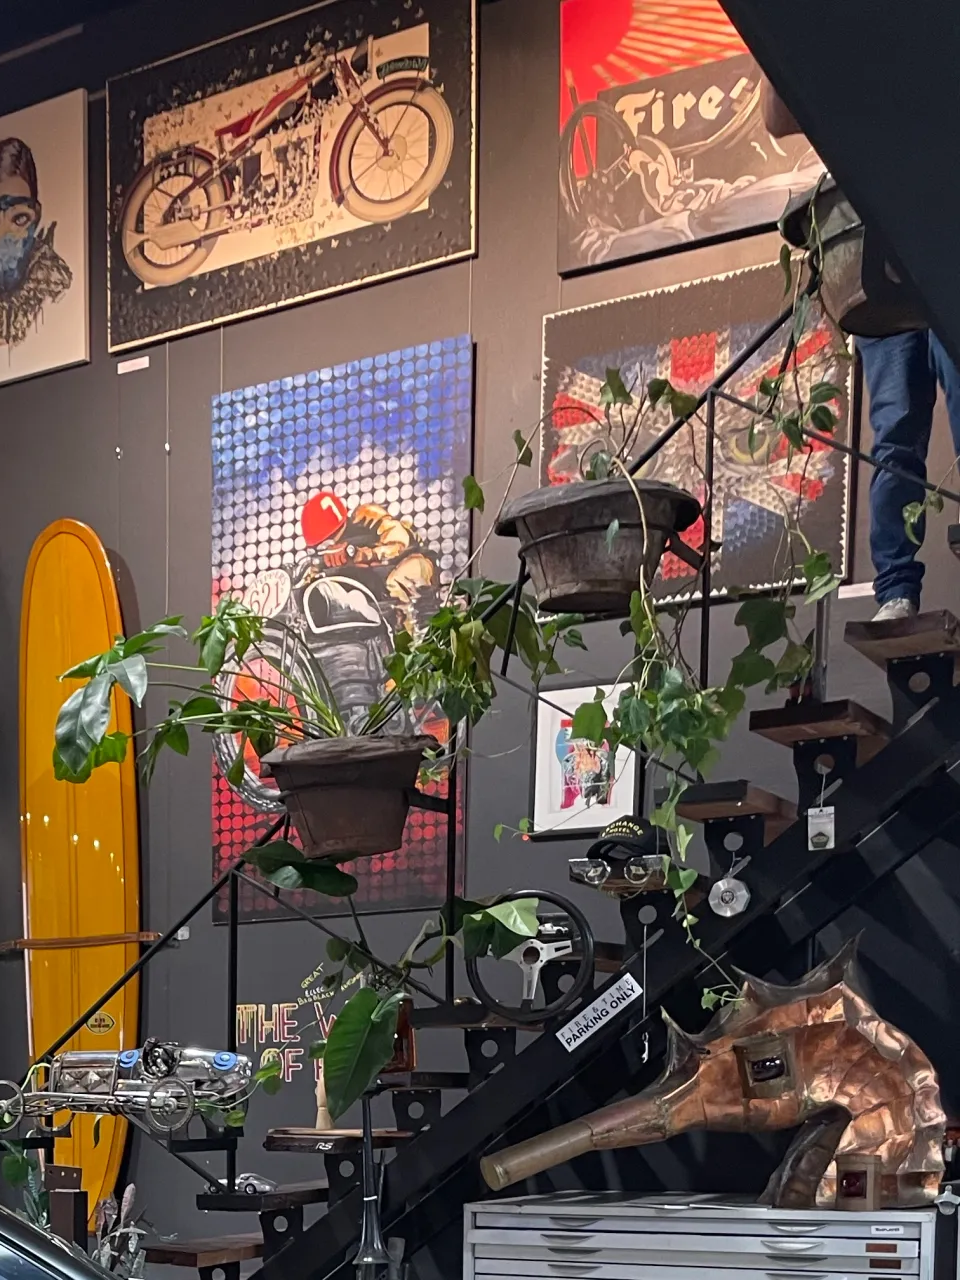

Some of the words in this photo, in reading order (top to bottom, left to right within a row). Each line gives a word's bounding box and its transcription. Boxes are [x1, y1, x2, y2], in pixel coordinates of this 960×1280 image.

[236, 1002, 301, 1046] THE
[565, 1008, 610, 1047] PARKING
[609, 984, 636, 1009] ONLY
